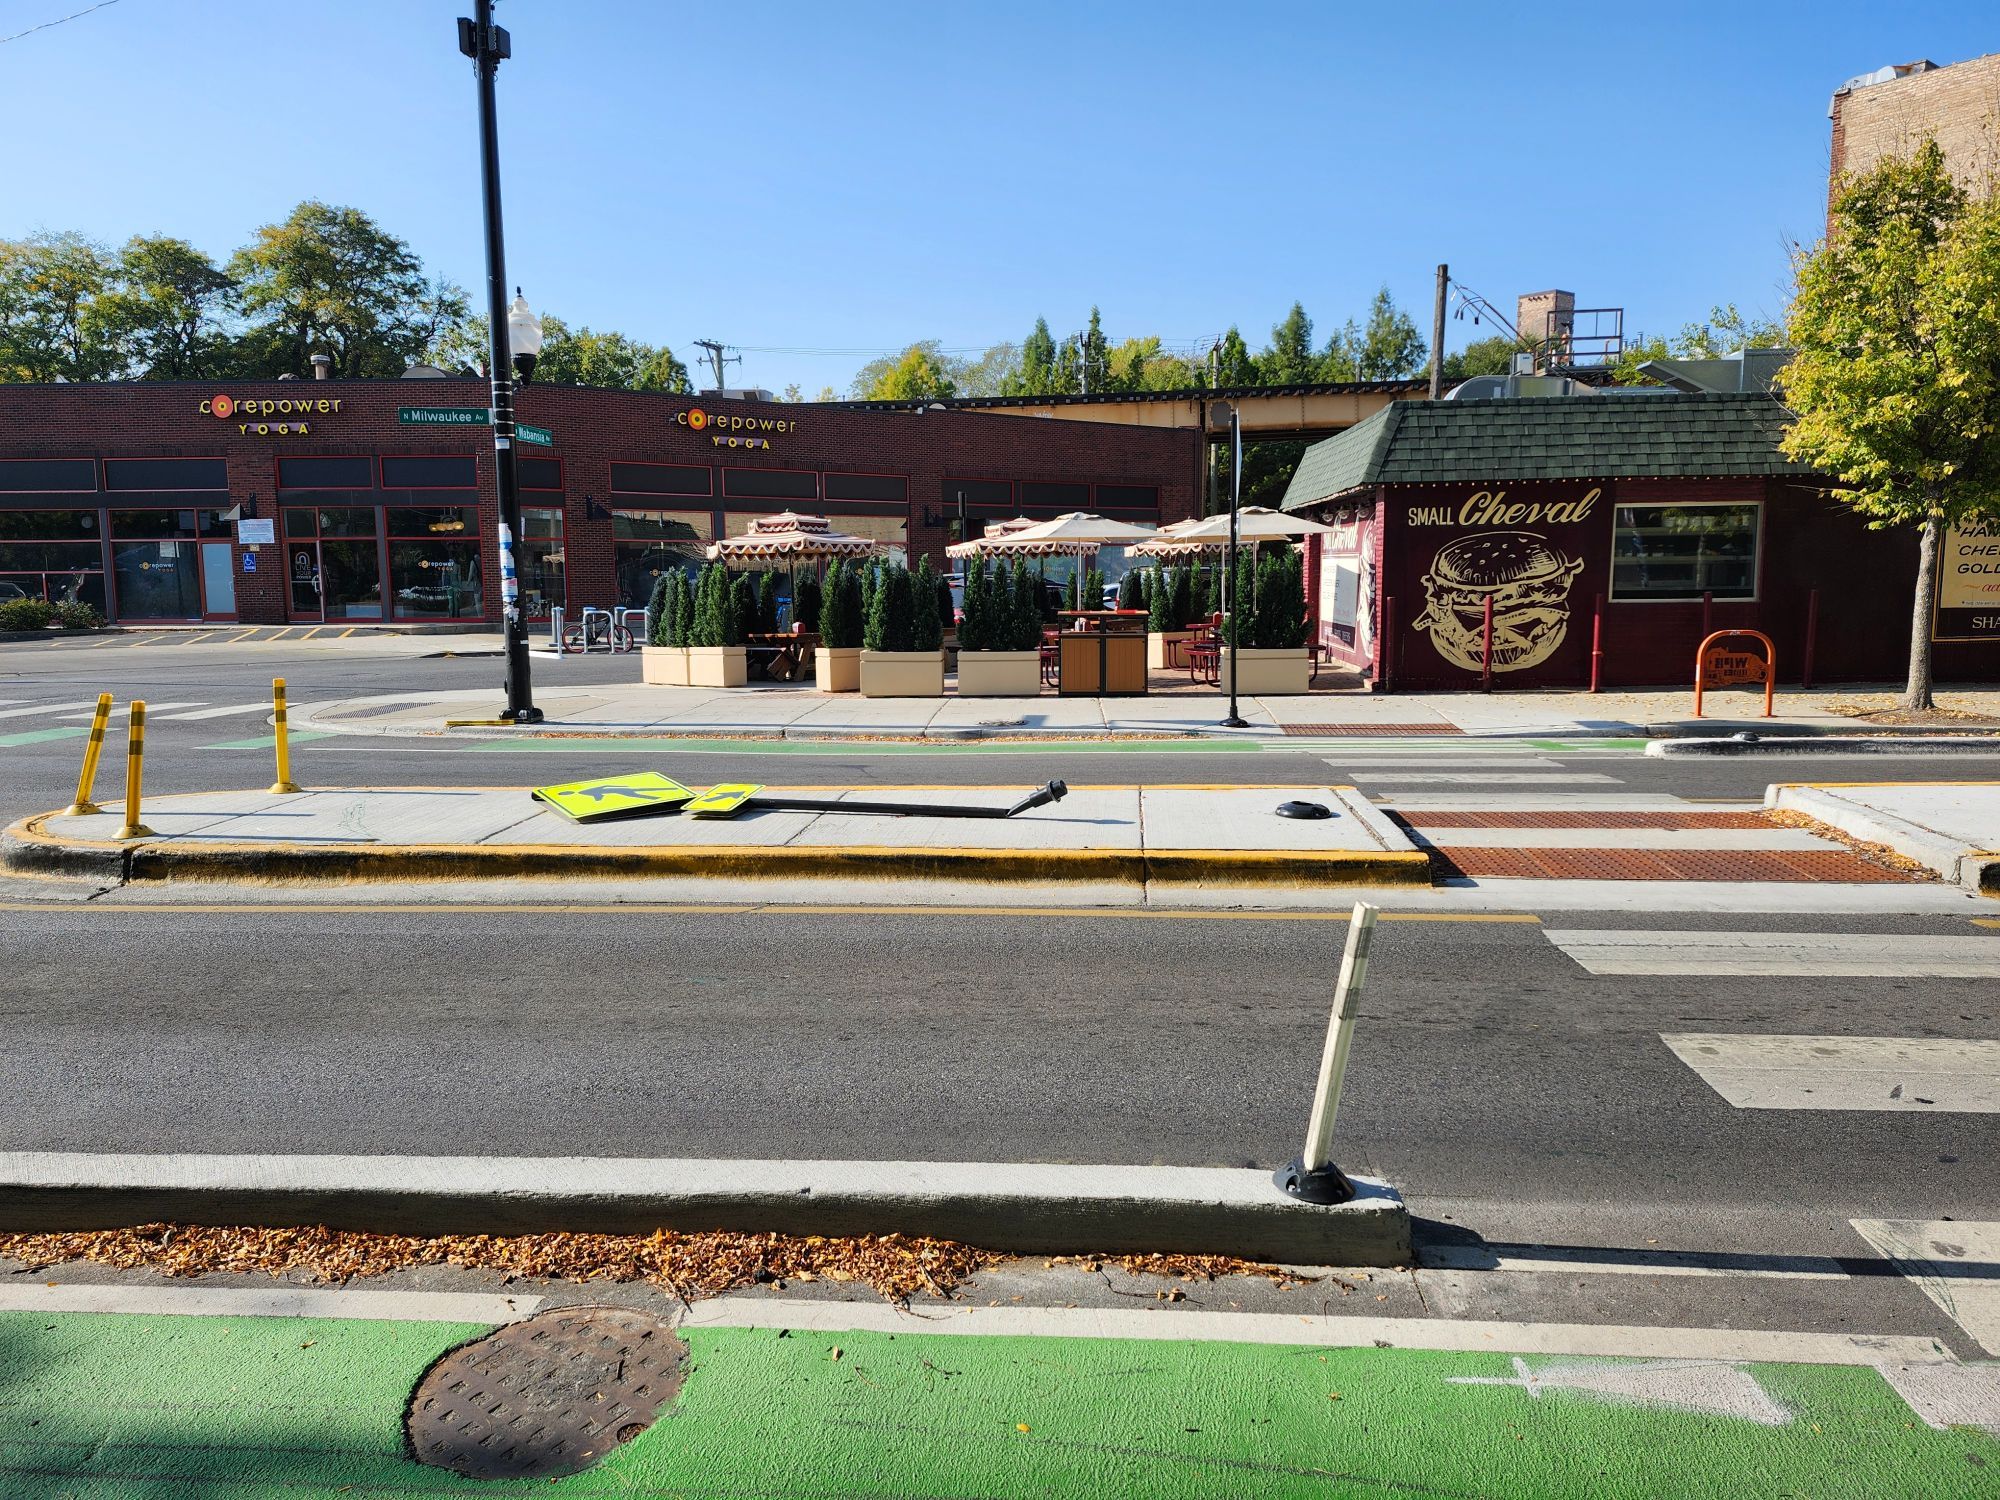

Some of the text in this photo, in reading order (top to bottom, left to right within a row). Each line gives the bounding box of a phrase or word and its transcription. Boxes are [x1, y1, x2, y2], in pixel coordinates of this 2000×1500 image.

[199, 395, 341, 418] corepower
[411, 410, 472, 422] Milwaukee
[677, 408, 796, 433] corepower
[238, 423, 309, 435] YOGA
[518, 428, 545, 442] Wabansia
[712, 436, 770, 449] YOGA
[1408, 487, 1601, 526] SMALL Cheval
[1959, 544, 2000, 555] CHE
[418, 560, 454, 569] corepower
